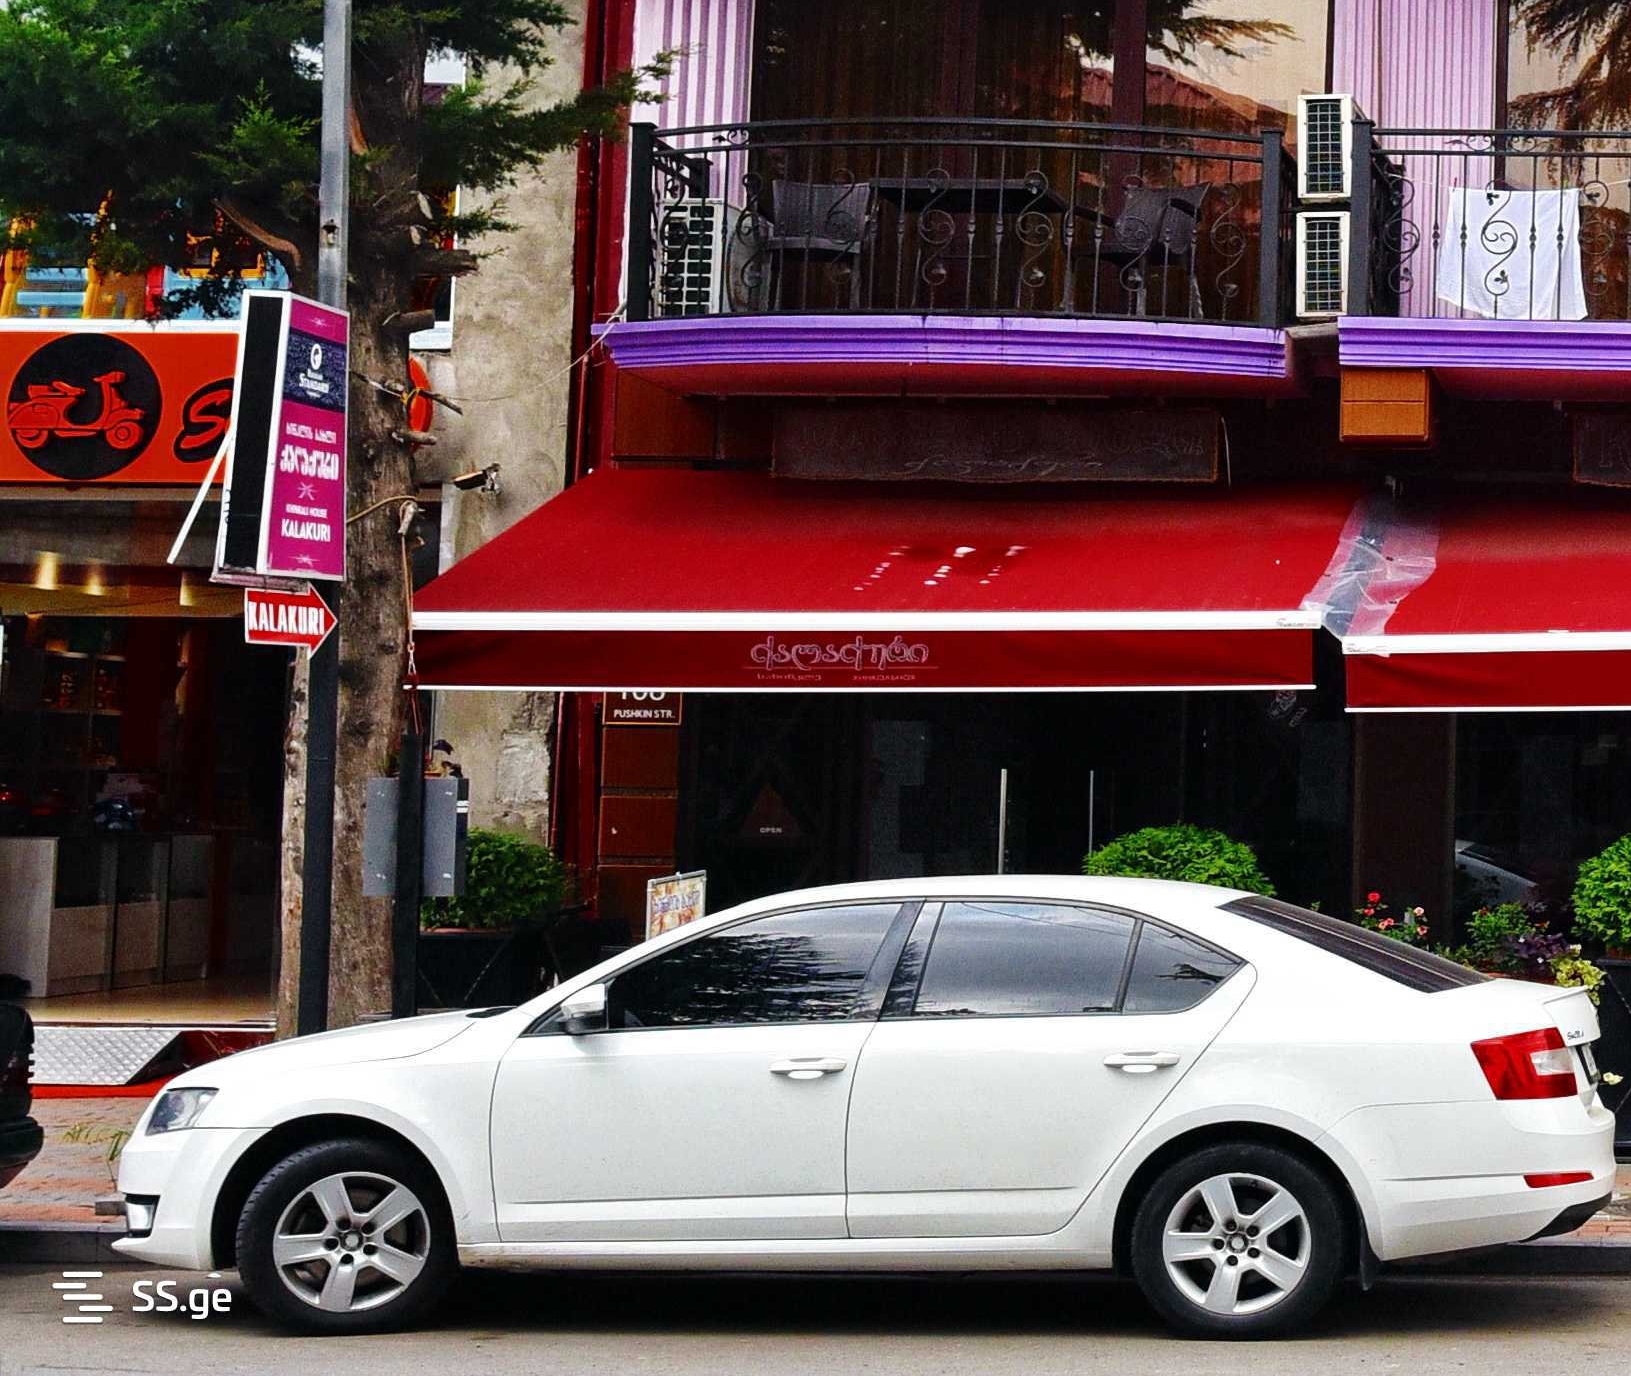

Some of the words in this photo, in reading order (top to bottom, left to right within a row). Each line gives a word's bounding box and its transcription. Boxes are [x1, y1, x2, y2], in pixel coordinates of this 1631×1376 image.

[281, 518, 331, 543] KALAKURI
[248, 601, 325, 635] KALAKURI
[613, 709, 652, 718] PUSHKIN
[653, 709, 676, 718] STR.
